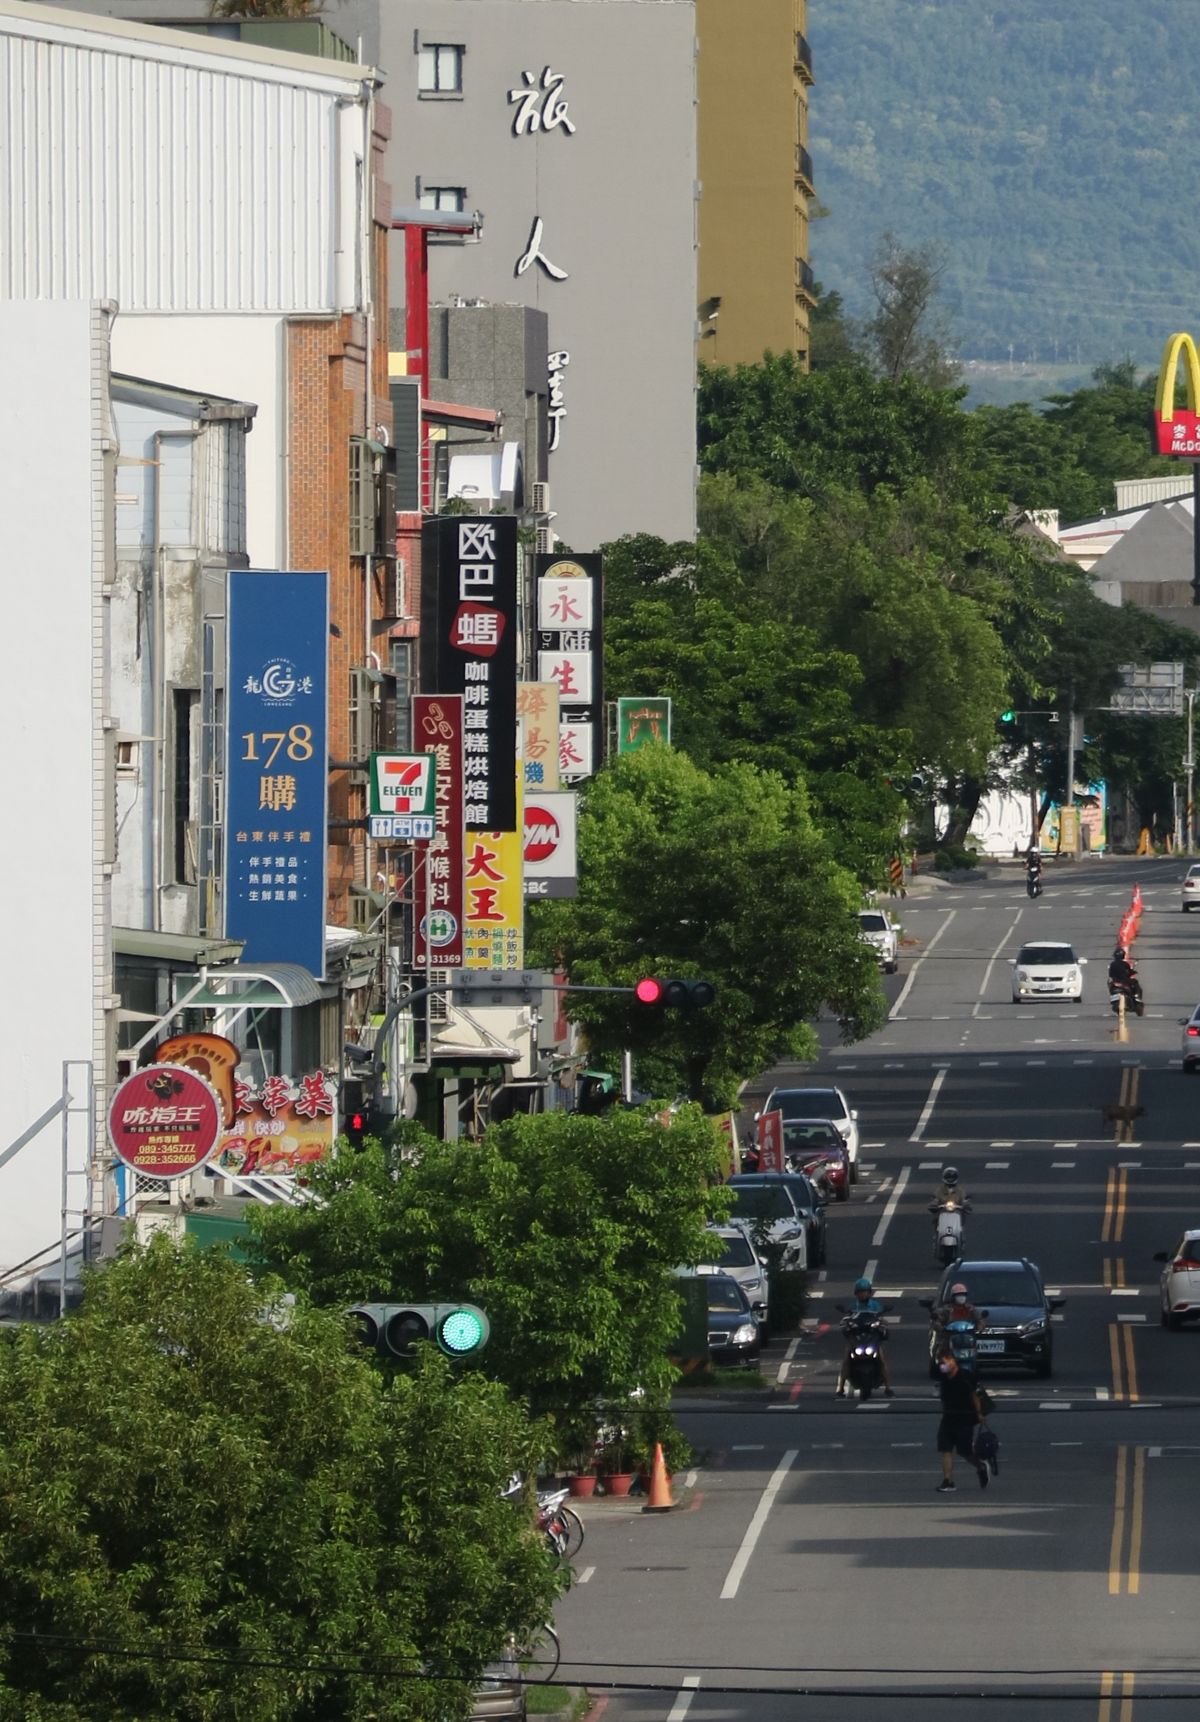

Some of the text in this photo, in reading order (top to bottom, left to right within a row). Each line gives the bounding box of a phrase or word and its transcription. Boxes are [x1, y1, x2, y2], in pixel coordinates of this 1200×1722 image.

[241, 723, 313, 768] 178
[464, 661, 489, 825] 咖啡蛋糕烘焙館
[258, 775, 296, 812] 購
[384, 761, 422, 812] 7
[236, 831, 311, 842] 台東伴手禮
[249, 857, 298, 867] 伴手禮品
[122, 1106, 201, 1124] 吮指王
[255, 1121, 284, 1135] 快炒
